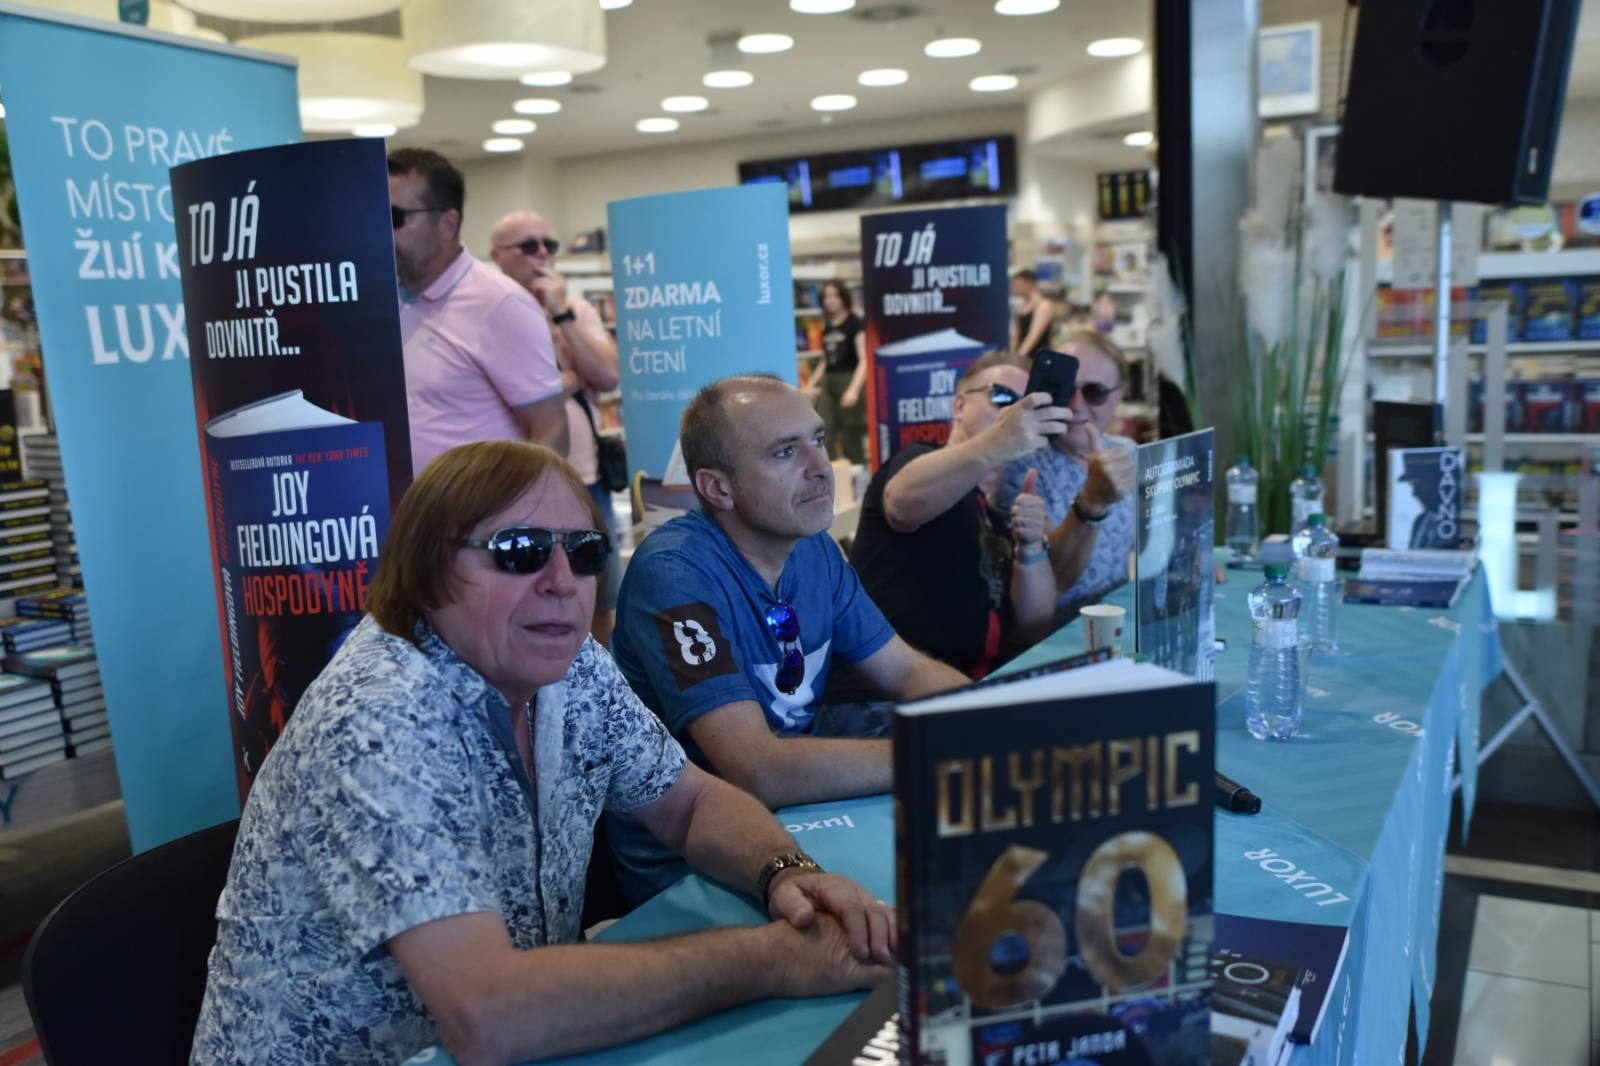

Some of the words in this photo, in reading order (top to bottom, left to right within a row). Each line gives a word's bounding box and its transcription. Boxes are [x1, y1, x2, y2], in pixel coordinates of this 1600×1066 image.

[51, 116, 114, 161] TO
[124, 127, 233, 167] PRAVÉ
[188, 201, 216, 266] TO
[222, 180, 260, 262] JÁ
[874, 232, 902, 268] TO
[903, 221, 937, 266] JÁ
[74, 228, 146, 280] ŽIJÍ
[622, 251, 655, 277] 1+1
[756, 243, 771, 305] luxor.cz
[912, 267, 925, 290] JI
[928, 262, 992, 288] PUSTILA
[235, 269, 251, 309] JI
[255, 261, 359, 308] PUSTILA
[624, 280, 722, 310] ZDARMA
[205, 310, 301, 359] DOVNITŘ...
[627, 320, 654, 342] NA
[659, 309, 721, 341] LETNÍ
[629, 345, 686, 375] ČTENÍ
[929, 369, 957, 395] JOY
[272, 470, 309, 517] JOY
[237, 505, 379, 568] FIELDINGOVÁ
[242, 562, 369, 617] HOSPODYNĚ
[673, 619, 716, 666] 8
[936, 730, 1200, 837] OLYMPIC
[1244, 848, 1350, 906] LUXOR
[953, 831, 1189, 1010] 60
[1067, 1029, 1126, 1060] JANDA
